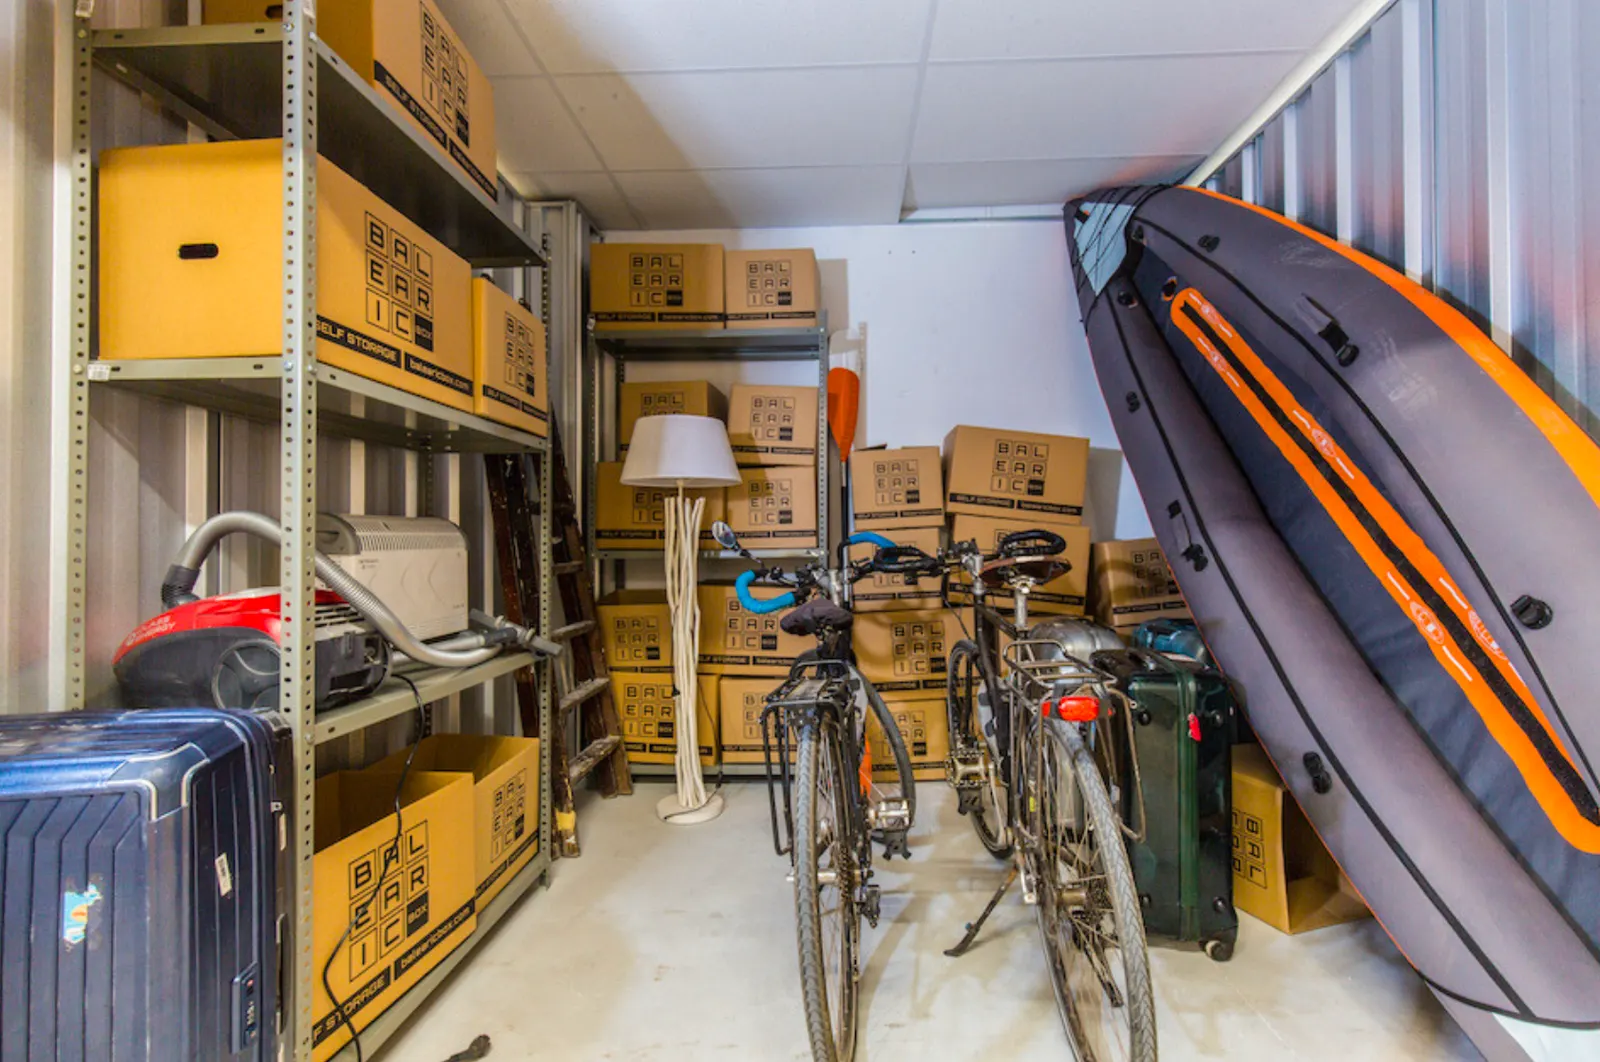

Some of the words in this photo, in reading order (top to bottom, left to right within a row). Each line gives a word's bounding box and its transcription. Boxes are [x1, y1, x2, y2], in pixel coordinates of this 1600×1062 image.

[370, 221, 430, 277] BAL
[632, 256, 679, 268] BAL
[749, 263, 787, 273] BAL
[370, 259, 430, 311] EAR
[633, 274, 680, 286] EAR
[749, 279, 789, 288] EAR
[636, 292, 662, 304] IC
[752, 294, 774, 304] IC
[376, 299, 410, 335] IC
[644, 396, 682, 405] BAL
[754, 398, 792, 409] BAL
[753, 413, 791, 422] EAR
[754, 428, 775, 438] IC
[998, 442, 1044, 458] BAL
[877, 461, 914, 473] BAL
[996, 460, 1043, 475] EAR
[751, 482, 788, 491] BAL
[878, 477, 916, 488] EAR
[998, 478, 1023, 491] IC
[751, 498, 789, 507] EAR
[881, 493, 902, 502] IC
[754, 513, 775, 522] IC
[616, 619, 656, 629] BAL
[728, 618, 775, 629] EAR
[894, 624, 942, 636] BAL
[732, 636, 756, 647] IC
[894, 642, 942, 654] EAR
[900, 661, 925, 671] IC
[627, 686, 672, 699] BAL
[627, 705, 672, 717] EAR
[629, 723, 654, 734] IC
[355, 835, 424, 889] BAL
[355, 865, 424, 929] EAR
[361, 918, 401, 966] IC
[408, 903, 428, 925] BOX
